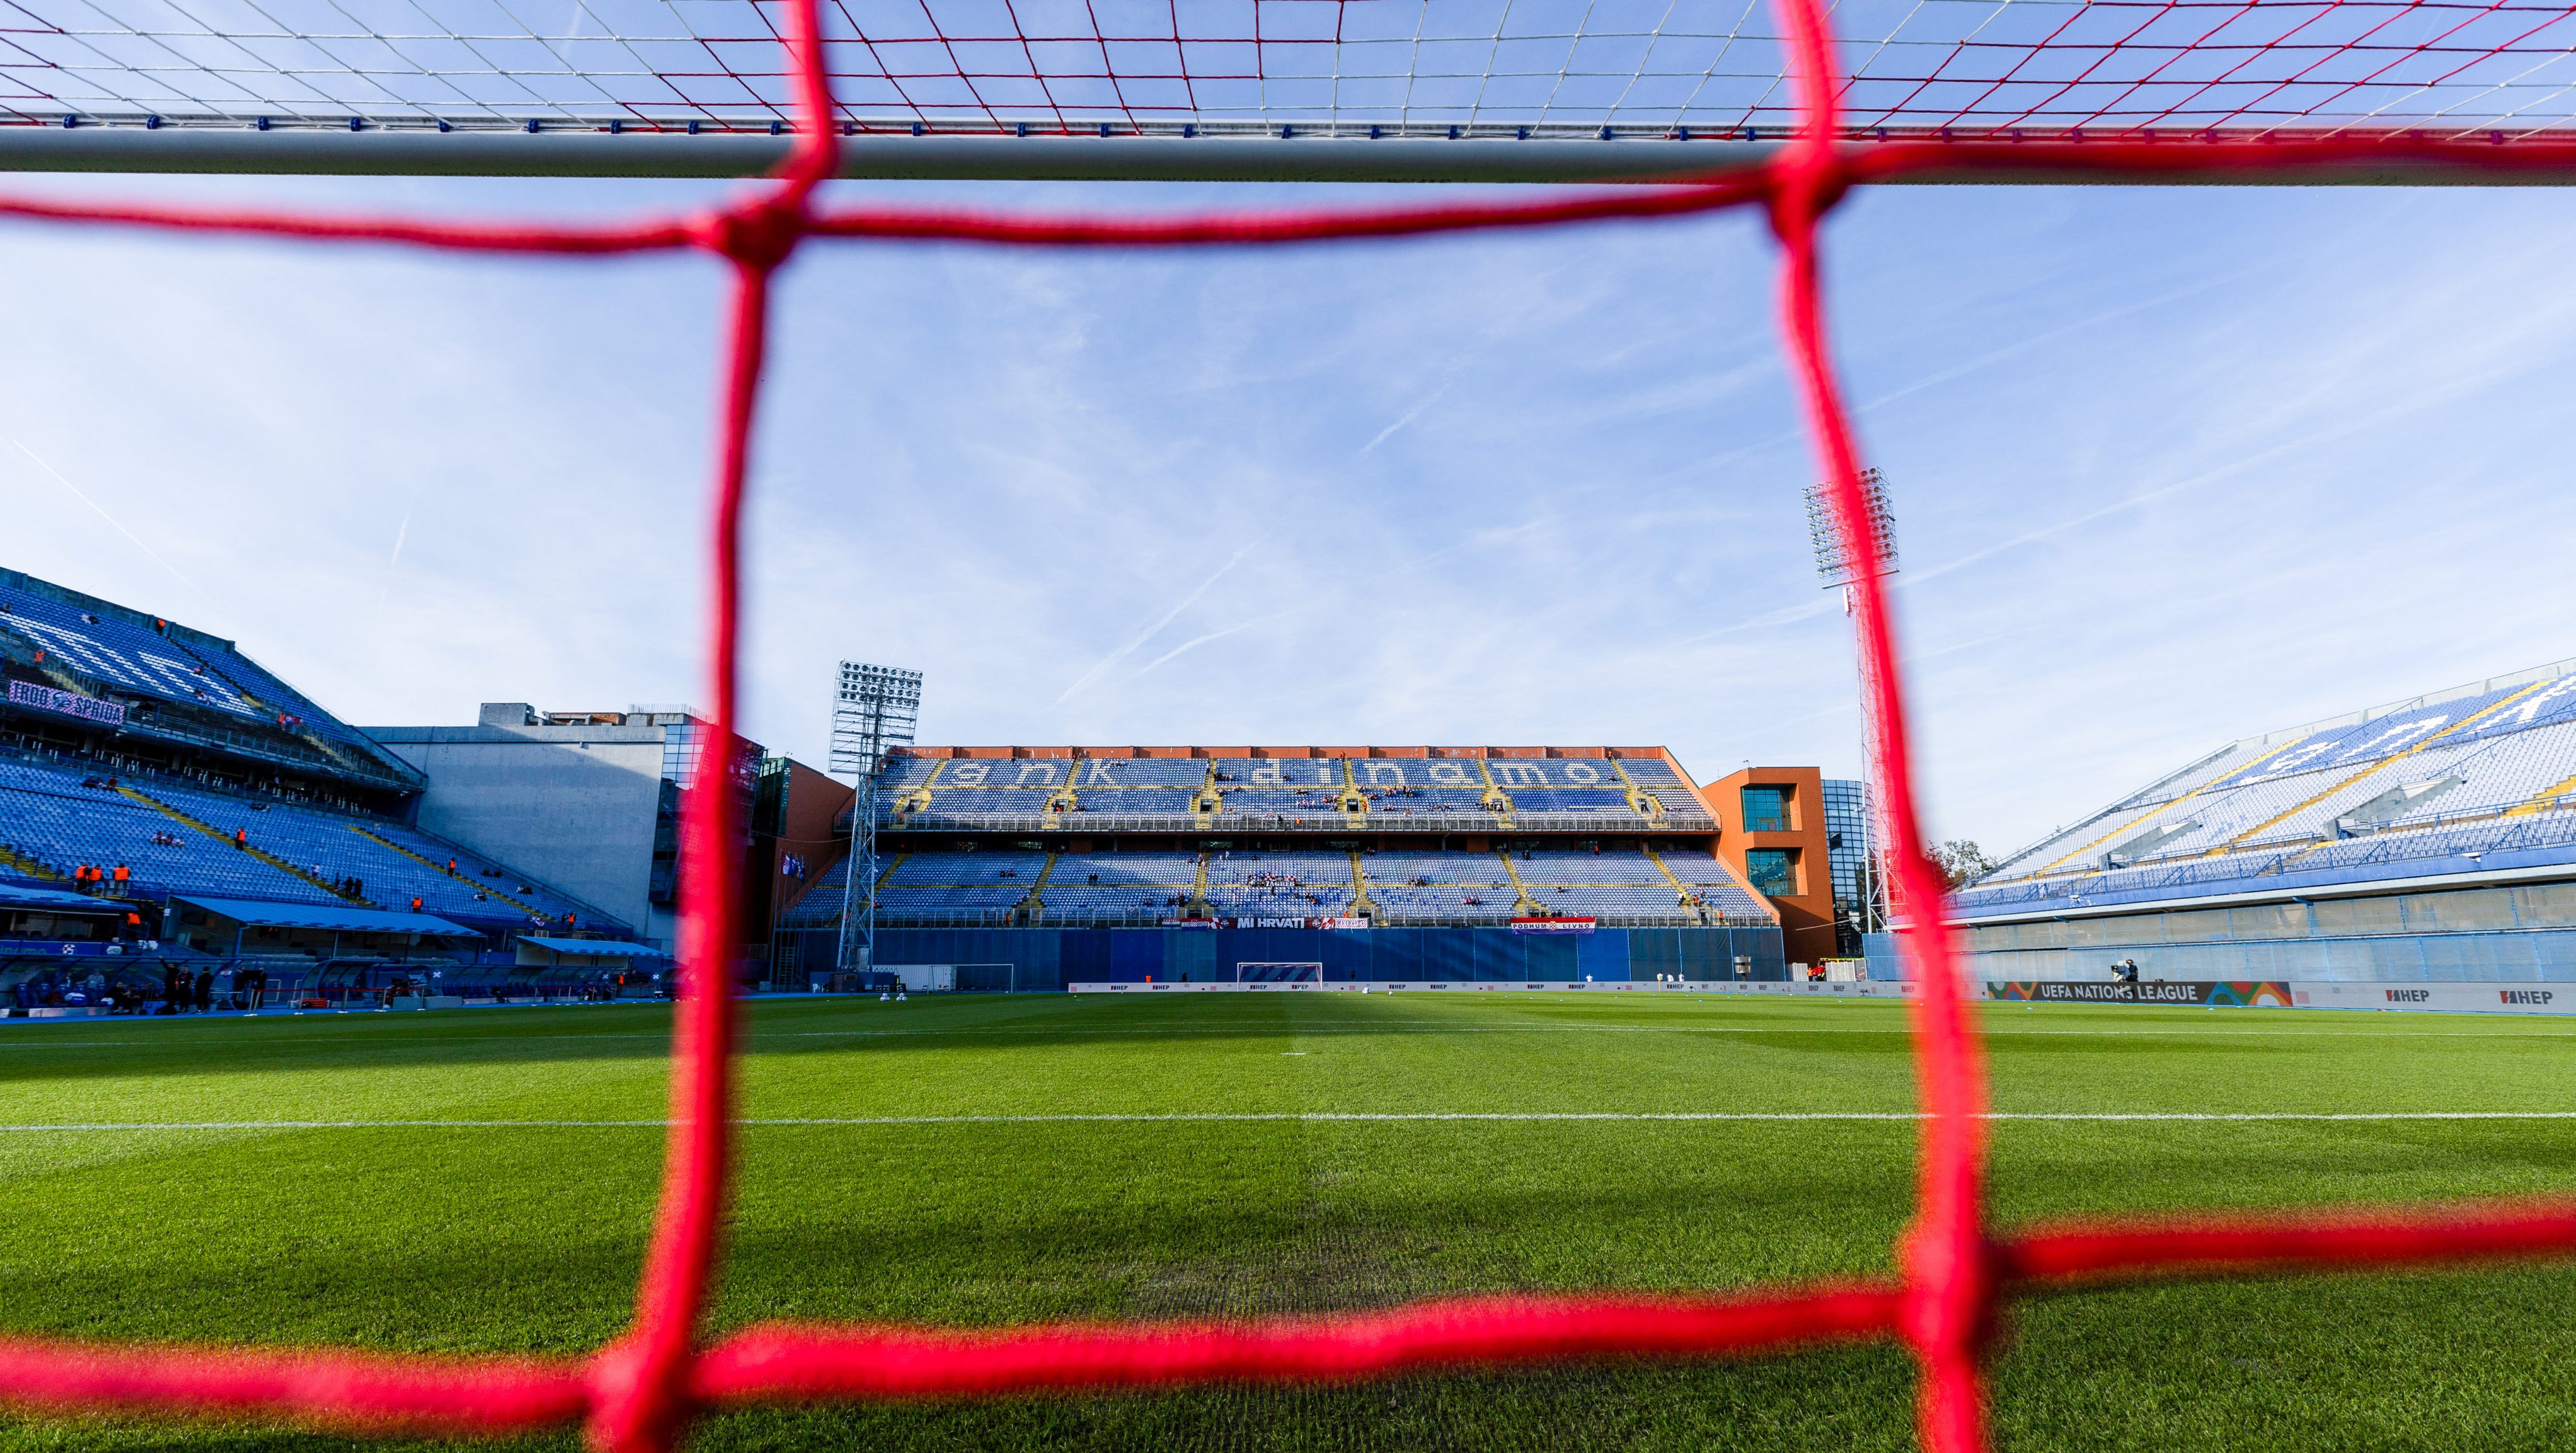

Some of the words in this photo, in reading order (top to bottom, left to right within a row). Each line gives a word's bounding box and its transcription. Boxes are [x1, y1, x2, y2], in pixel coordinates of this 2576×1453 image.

[14, 682, 49, 705] TRDO
[75, 697, 120, 723] SPRIDA
[1237, 917, 1254, 929] MI
[1257, 917, 1304, 929] HRVATI
[2041, 984, 2073, 998] UEFA
[2075, 984, 2134, 999] NATIONS
[2137, 985, 2198, 1001] LEAGUE
[2401, 989, 2430, 1002] HEP
[2517, 991, 2553, 1004] HEP
